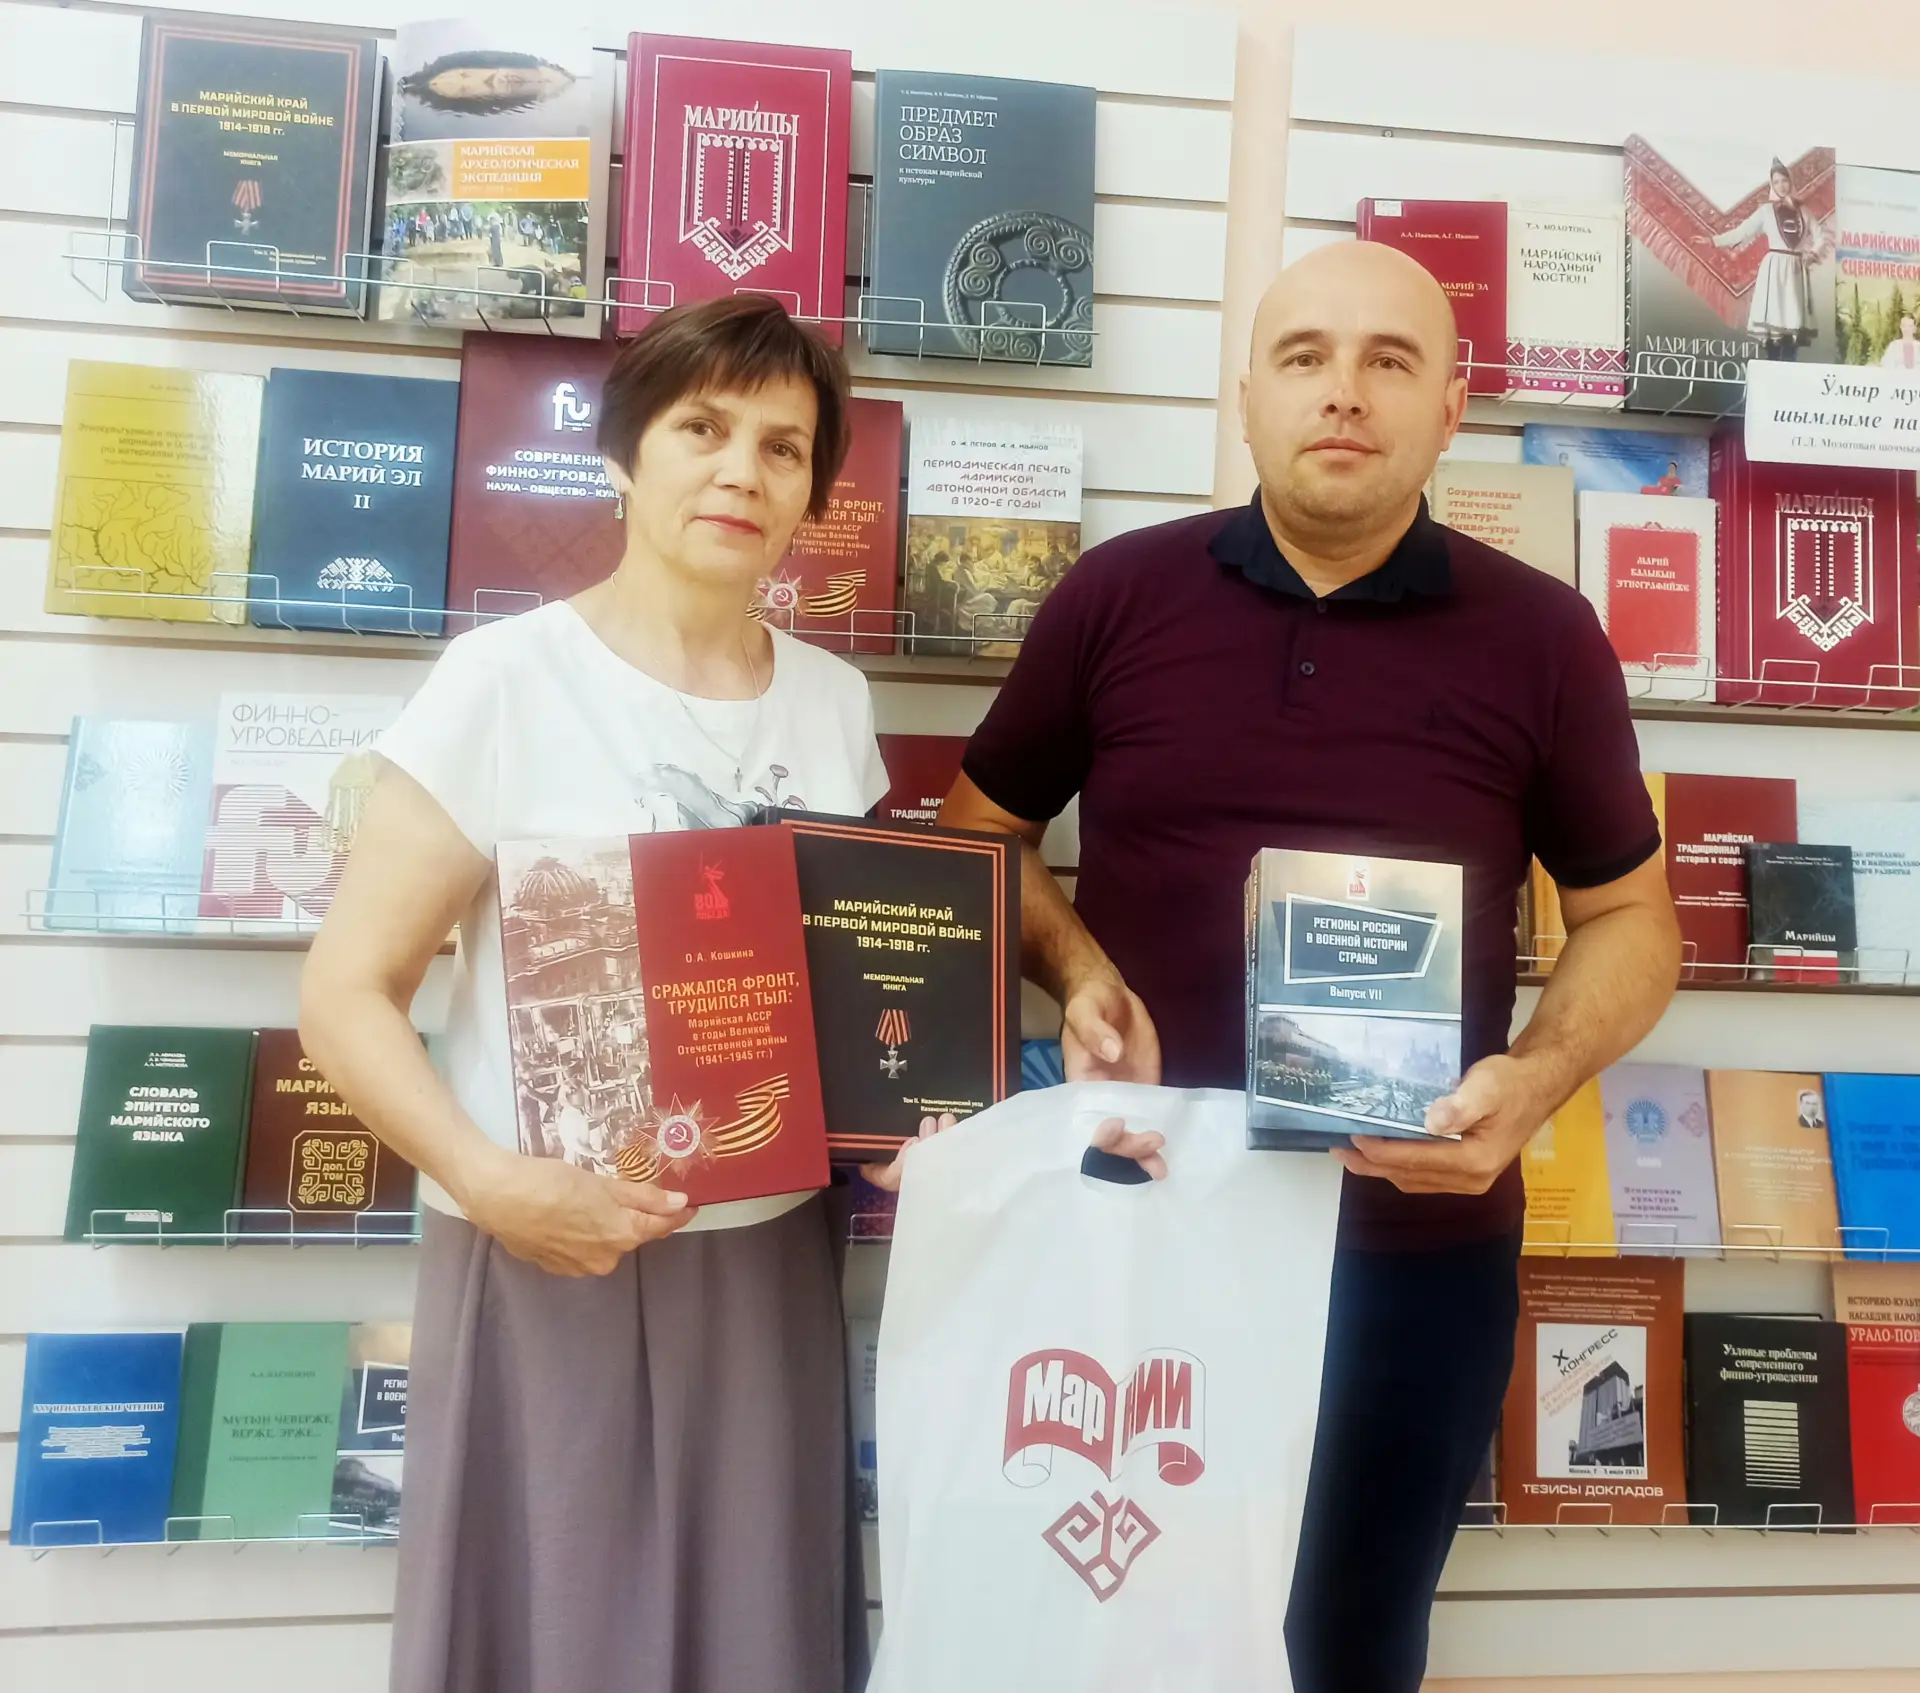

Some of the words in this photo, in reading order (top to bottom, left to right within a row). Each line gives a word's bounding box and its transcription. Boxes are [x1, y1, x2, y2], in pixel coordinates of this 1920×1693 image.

[200, 91, 274, 106] МАРИЙСКИЙ
[277, 98, 308, 109] КРАЙ
[171, 102, 179, 112] В
[182, 103, 229, 116] ПЕРВОЙ
[232, 110, 291, 122] МИРОВОЙ
[294, 112, 334, 126] ВОЙНЕ
[683, 102, 799, 137] МАРИЙЦЫ
[900, 106, 998, 128] ПРЕДМЕТ
[900, 125, 963, 144] ОБРАЗ
[460, 146, 535, 157] МАРИЙСКАЯ
[899, 143, 987, 165] СИМВОЛ
[460, 159, 579, 169] АРХЕОЛОГИЧЕСКАЯ
[460, 172, 542, 183] ЭКСПЕДИЦИЯ
[899, 176, 936, 185] культуры
[905, 167, 938, 176] истокам
[939, 169, 983, 180] марийской
[1544, 224, 1592, 234] МОЛОТОВА
[1520, 247, 1602, 264] МАРИЙСКИЙ
[1523, 260, 1594, 273] НАРОДНЫЙ
[1532, 272, 1587, 284] КОСТЮМ
[1476, 283, 1489, 291] ЭЛ
[1646, 334, 1759, 358] МАРИЙСКИЙ
[1890, 387, 1920, 406] му
[1773, 409, 1882, 429] шымлыме
[303, 438, 424, 464] ИСТОРИЯ
[514, 449, 605, 467] СОВРЕМЕНН
[923, 459, 1025, 473] ПЕРИОДИЧЕСКАЯ
[1028, 463, 1071, 475] ПЕЧАТЬ
[301, 463, 386, 485] МАРИЙ
[390, 469, 422, 487] ЭЛ
[485, 464, 612, 486] ФИННО-УГРОВЕД
[486, 481, 521, 493] НАУКА
[530, 484, 587, 497] ОБЩЕСТВО
[1012, 487, 1067, 498] ОБЛАСТИ
[1447, 487, 1522, 500] Современная
[353, 494, 371, 510] II
[843, 499, 885, 513] ФРОНТ,
[951, 496, 959, 505] В
[963, 496, 1003, 507] 1920-Е
[1007, 500, 1042, 509] ГОДЫ
[1775, 491, 1875, 518] МАРИЙЦЫ
[851, 511, 878, 523] ТЫЛ:
[1636, 556, 1669, 567] МАРИЙ
[233, 702, 340, 725] ФИННО-
[891, 808, 940, 820] ТРАДИЦИО
[1703, 833, 1754, 844] МАРИЙСКАЯ
[1676, 844, 1741, 855] ТРАДИЦИОННАЯ
[834, 899, 917, 918] МАРИЙСКИЙ
[919, 906, 953, 921] КРАЙ
[802, 914, 811, 925] В
[814, 914, 868, 931] ПЕРВОЙ
[871, 919, 936, 937] МИРОВОЙ
[938, 925, 982, 941] ВОЙНЕ
[1313, 917, 1360, 932] РЕГИОНЫ
[1362, 921, 1401, 935] РОССИИ
[917, 943, 931, 953] гг.
[1306, 932, 1313, 943] В
[1316, 933, 1360, 948] ВОЕННОЙ
[1363, 937, 1408, 952] ИСТОРИИ
[710, 949, 754, 961] Кошкина
[1338, 951, 1378, 965] СТРАНЫ
[651, 977, 737, 1000] СРАЖАЛСЯ
[742, 971, 800, 989] ФРОНТ,
[863, 973, 924, 985] МЕМОРИАЛЬНАЯ
[882, 983, 907, 992] КНИГА
[1329, 985, 1366, 1000] Выпуск
[1368, 988, 1382, 1001] VII
[668, 993, 749, 1015] ТРУДИЛСЯ
[754, 989, 793, 1006] ТЫЛ:
[688, 1014, 743, 1029] Марийская
[746, 1010, 772, 1022] АССР
[692, 1032, 699, 1041] в
[702, 1030, 727, 1041] годы
[729, 1024, 771, 1037] Великой
[677, 1037, 753, 1055] Отечественной
[756, 1035, 788, 1046] войны
[129, 1086, 198, 1098] СЛОВАРЬ
[124, 1101, 200, 1113] ЭПИТЕТОВ
[110, 1113, 210, 1128] МАРИЙСКОГО
[132, 1130, 184, 1142] ЯЗЫКА
[322, 1163, 345, 1172] ДОП.
[323, 1172, 343, 1181] ТОМ
[1559, 1328, 1619, 1376] КОНГРЕСС
[1723, 1343, 1767, 1358] Узловые
[1768, 1347, 1817, 1361] проблемы
[1735, 1359, 1804, 1371] современного
[1720, 1367, 1818, 1384] финно-угроведения
[383, 1379, 408, 1388] РЕГИО
[376, 1391, 382, 1401] В
[1522, 1483, 1582, 1496] ТЕЗИСЫ
[1585, 1485, 1664, 1498] ДОКЛАДОВ
